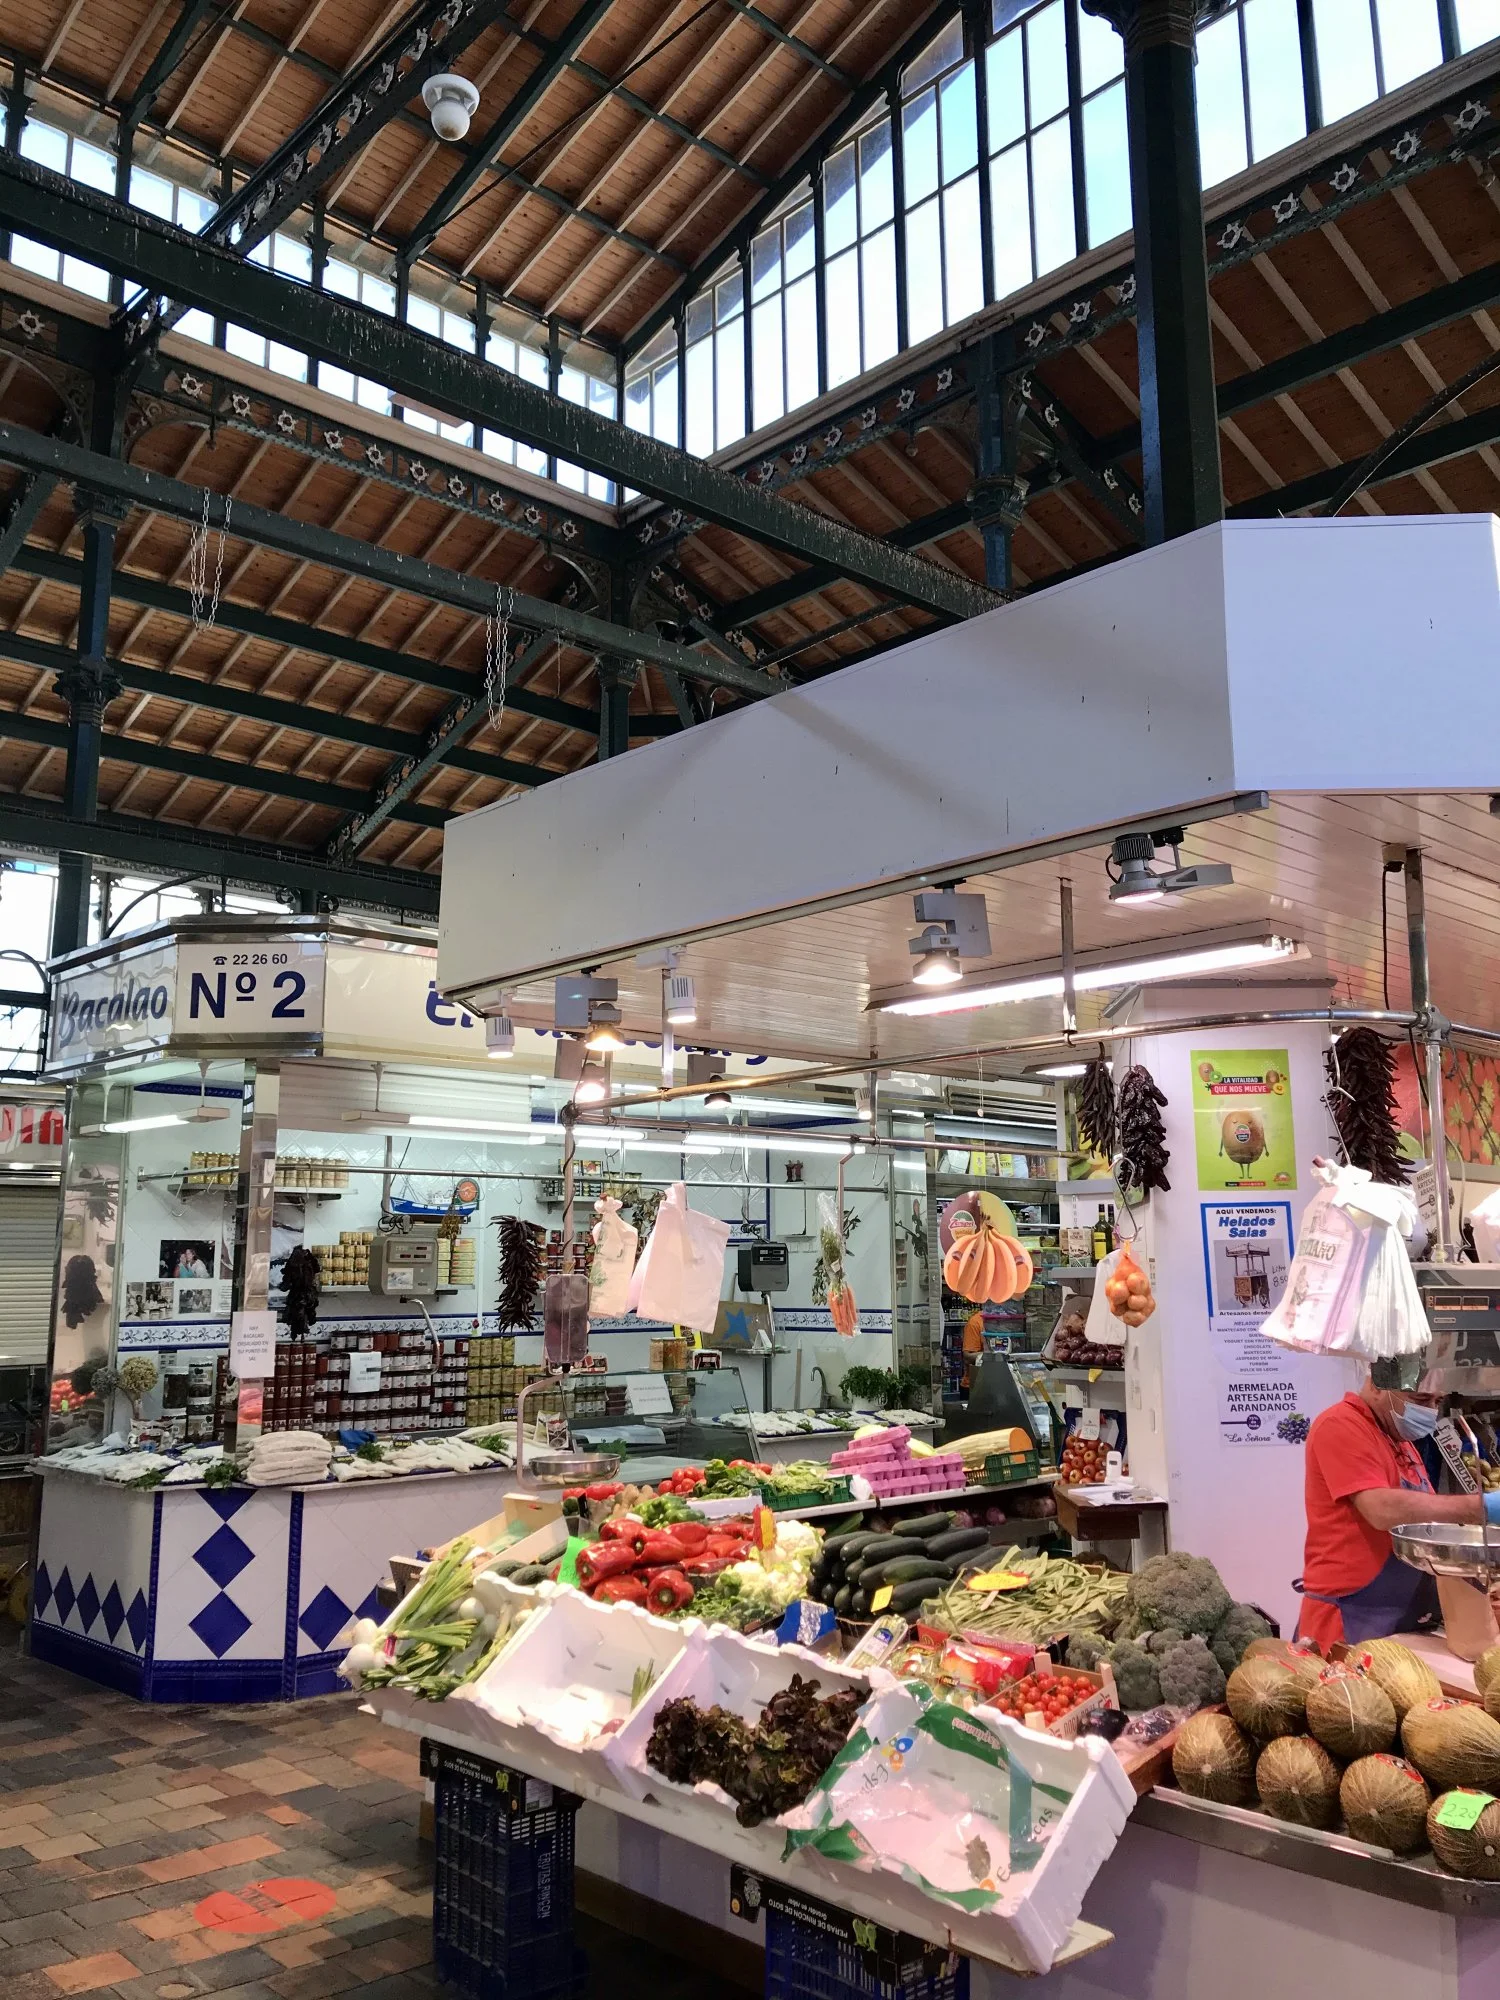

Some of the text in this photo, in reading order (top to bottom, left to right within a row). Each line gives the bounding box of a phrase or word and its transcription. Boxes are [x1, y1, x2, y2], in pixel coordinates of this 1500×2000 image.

[233, 954, 288, 965] 22 26 60
[190, 971, 306, 1018] Nº 2
[60, 978, 168, 1049] Bacalao
[1230, 1085, 1243, 1093] NOS
[1244, 1084, 1266, 1092] MUEVE
[1219, 1216, 1276, 1227] Helados
[1229, 1227, 1267, 1238] Salas
[1229, 1383, 1294, 1392] MERMELADA
[1227, 1393, 1298, 1402] ARTESANA DE
[1230, 1403, 1296, 1412] ARANDANOS
[768, 1899, 848, 1938] PERAS DE RINCÓN DE SOTO
